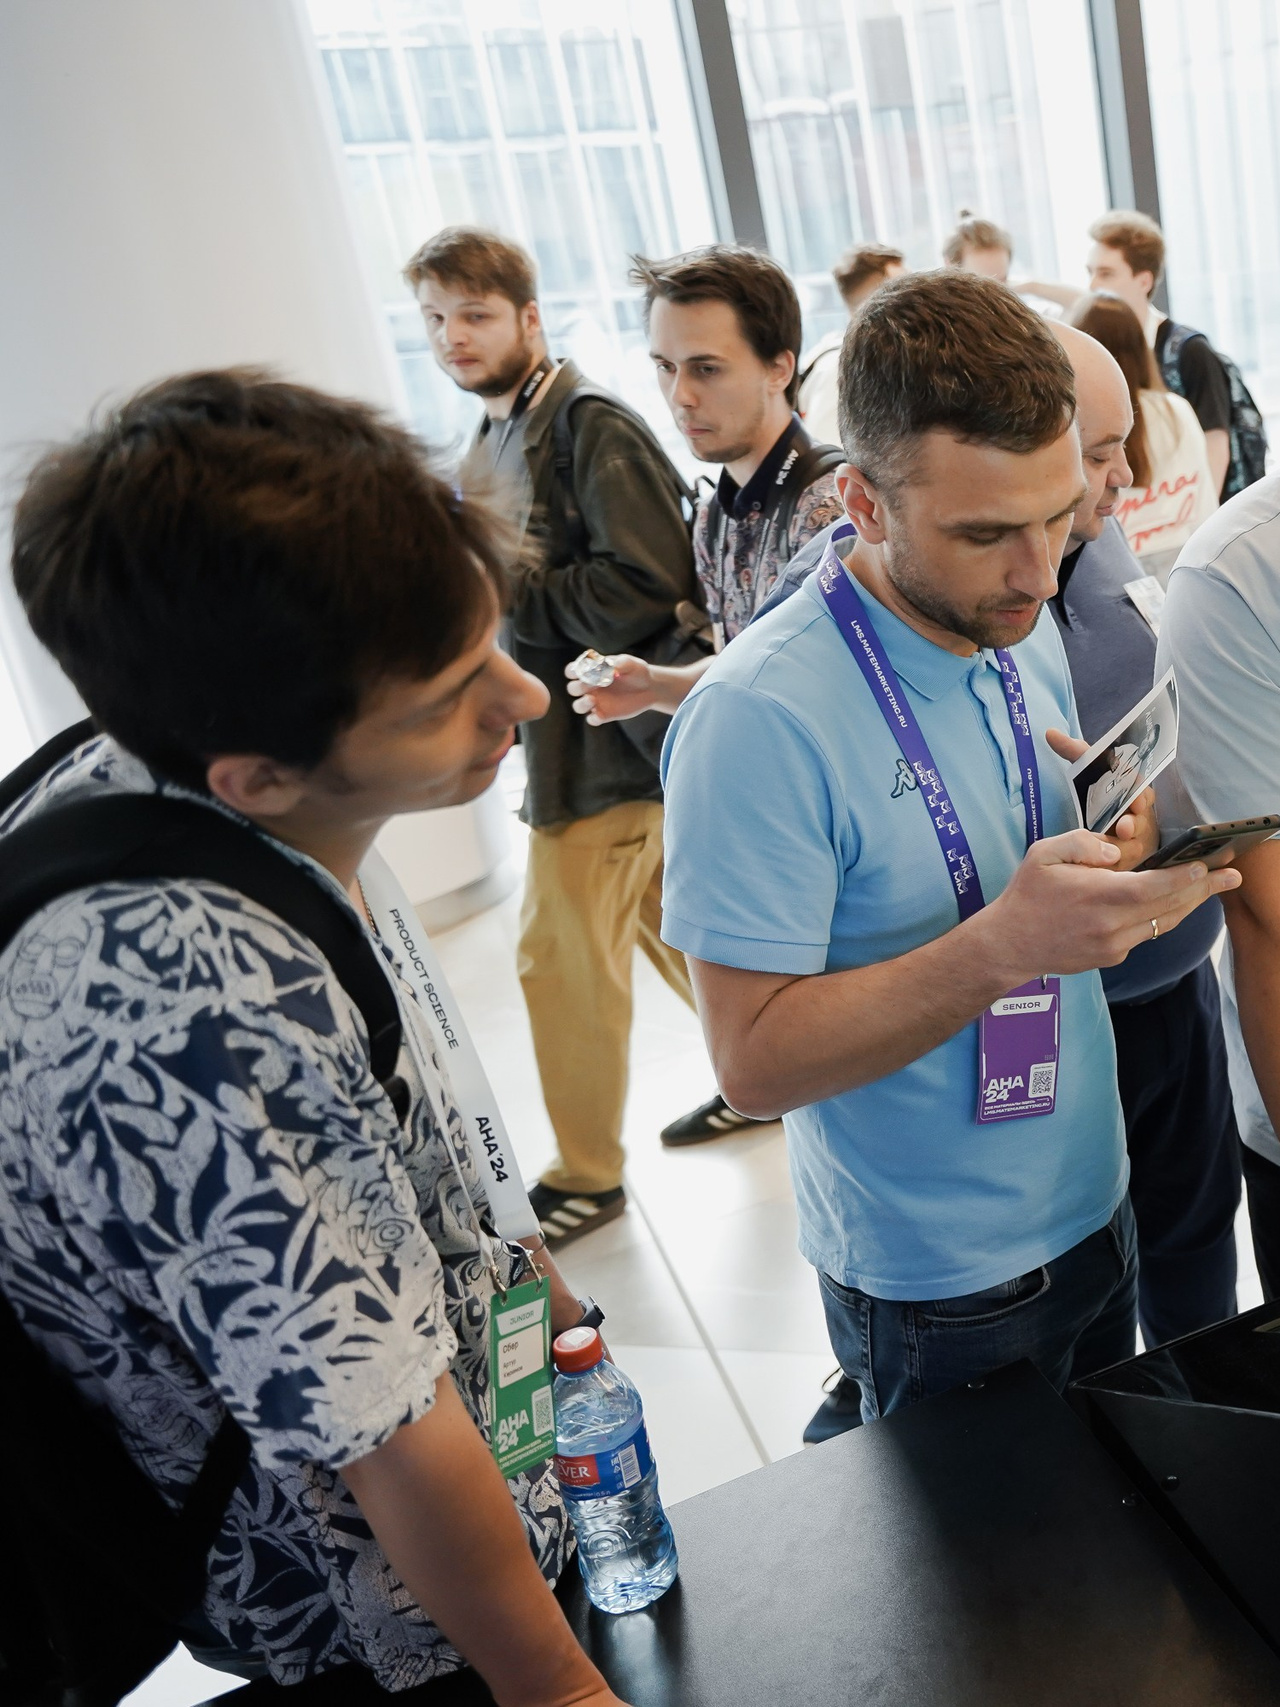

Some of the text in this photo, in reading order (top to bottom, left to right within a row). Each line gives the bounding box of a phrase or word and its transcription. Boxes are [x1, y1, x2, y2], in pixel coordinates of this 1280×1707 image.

[850, 620, 907, 728] LMS.MATEMARKETING.RU
[389, 908, 431, 980] PRODUCT
[423, 982, 459, 1050] SCIENCE
[1002, 1001, 1041, 1011] SENIOR
[986, 1075, 1024, 1091] AHA
[475, 1116, 509, 1182] AHA'24
[503, 1341, 518, 1354] Сбер
[498, 1409, 529, 1434] AHA
